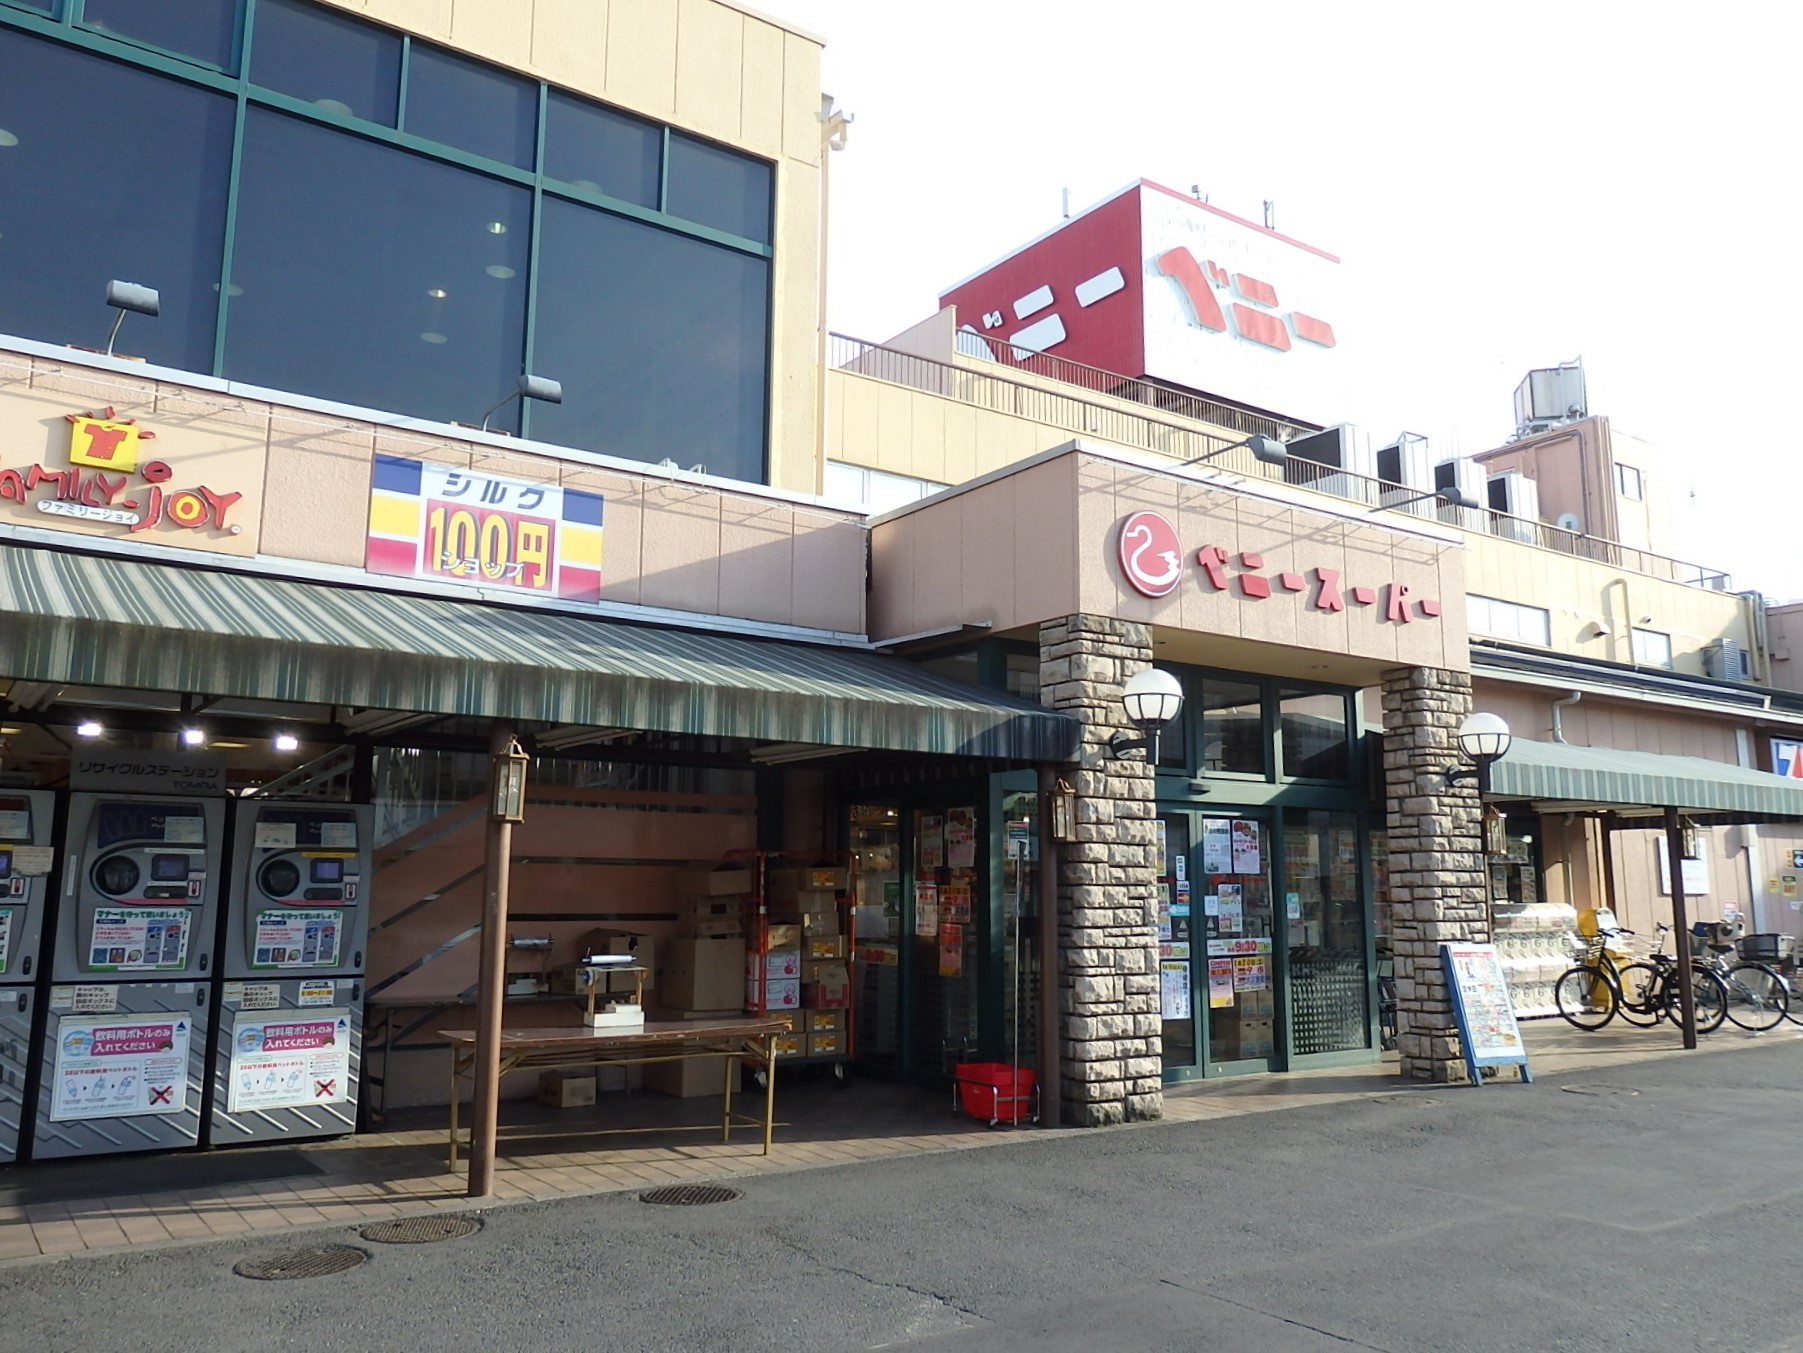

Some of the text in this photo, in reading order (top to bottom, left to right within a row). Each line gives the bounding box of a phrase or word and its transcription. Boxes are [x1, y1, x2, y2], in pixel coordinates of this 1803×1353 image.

[441, 472, 546, 511] シルク
[41, 500, 135, 524] ファミリージョイ
[429, 506, 550, 588] 100円
[440, 551, 525, 578] ショップ
[1196, 543, 1442, 623] ベニースーパー
[78, 760, 220, 779] リサイクルステーション
[172, 780, 218, 790] TOMRA
[1235, 940, 1257, 952] 9:30
[95, 1028, 172, 1042] 飲料用ボトルのみ
[265, 1026, 333, 1038] 飲料用ボトルのみ
[94, 1042, 156, 1053] 入れてください
[265, 1038, 320, 1050] 入れてください
